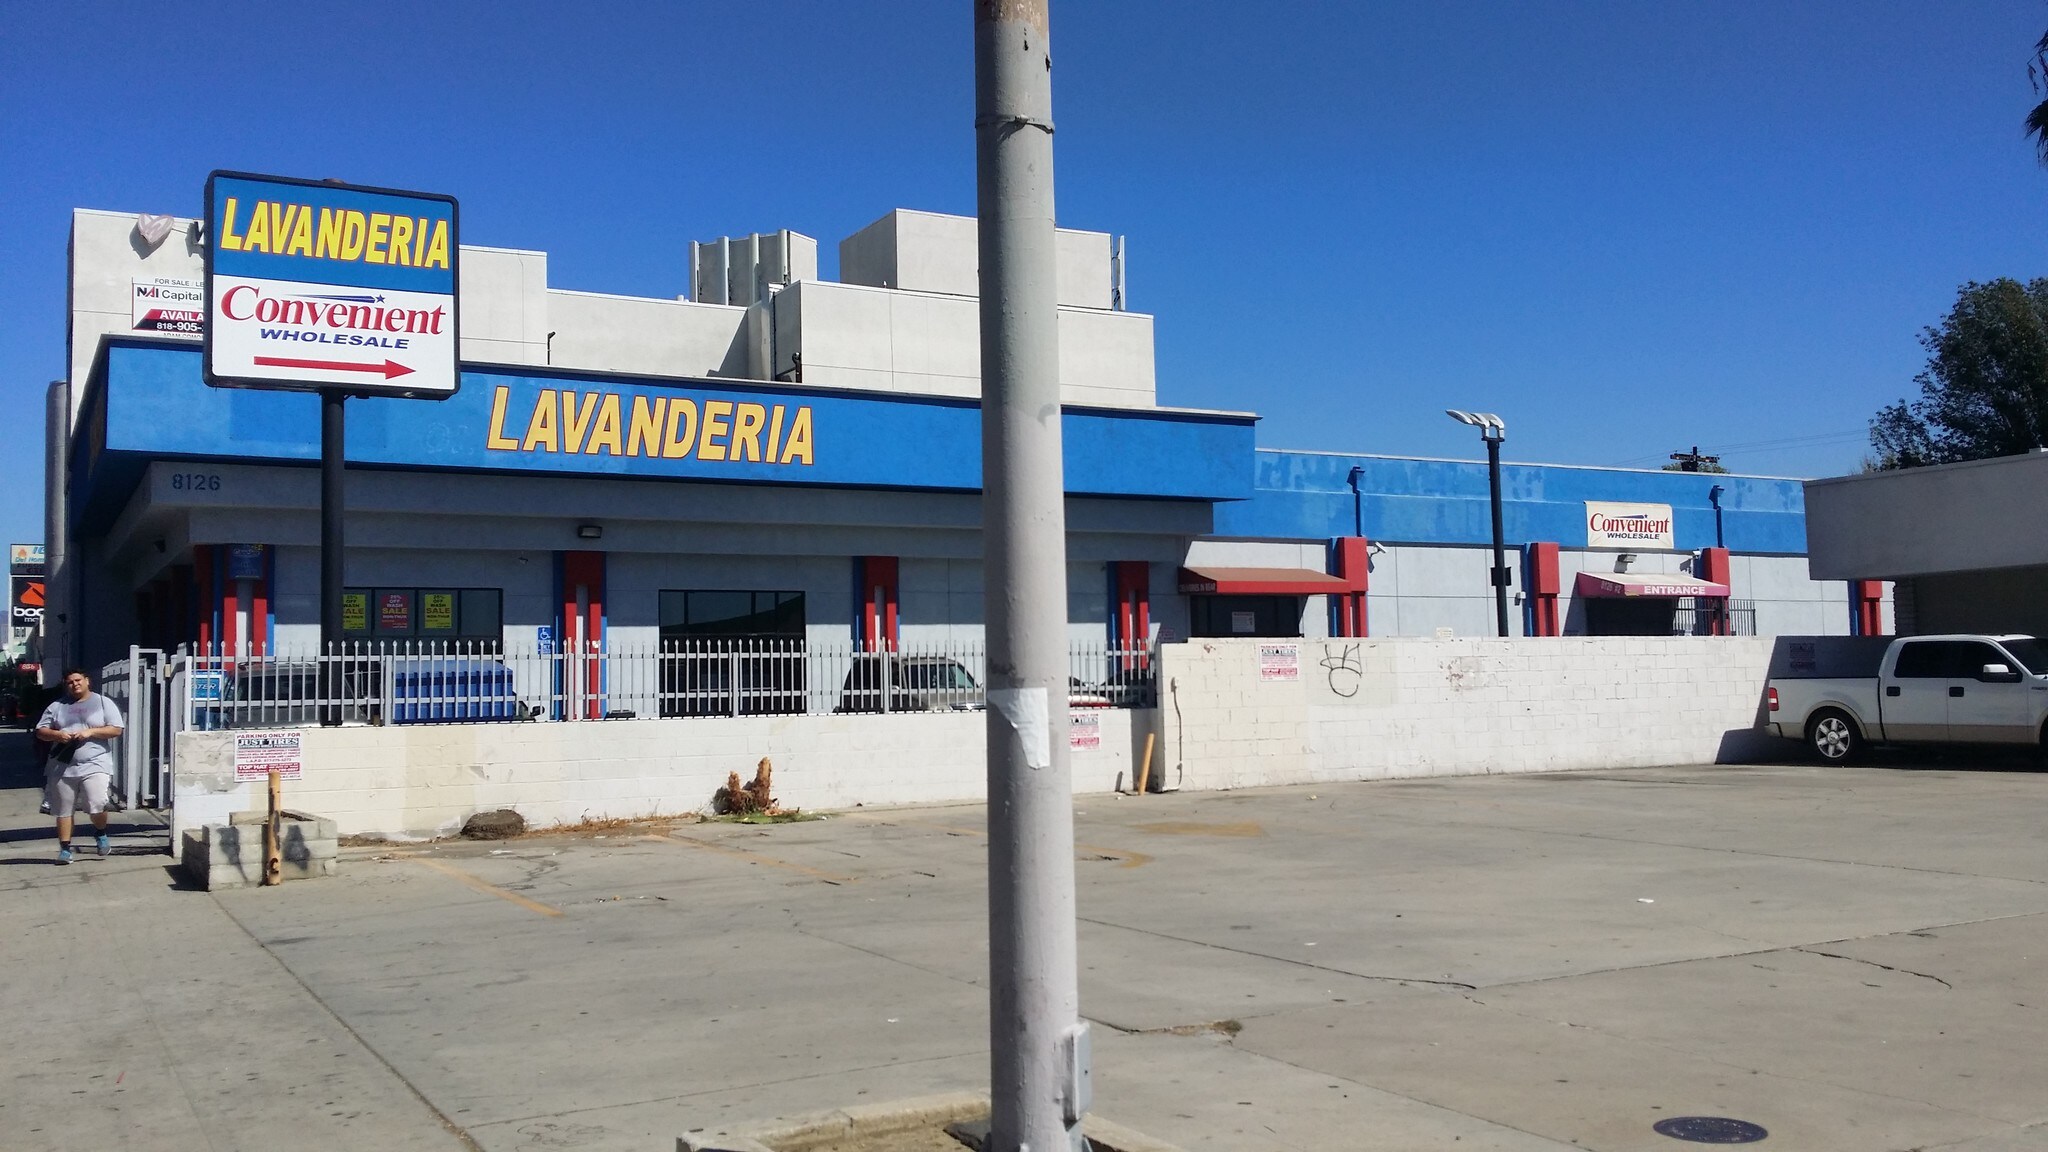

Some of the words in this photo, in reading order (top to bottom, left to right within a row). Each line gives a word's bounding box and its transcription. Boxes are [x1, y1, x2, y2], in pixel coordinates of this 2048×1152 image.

[220, 197, 450, 269] LAVANDERIA
[137, 286, 159, 299] NAI
[162, 289, 202, 302] Capital
[221, 285, 446, 336] Convenient
[156, 321, 204, 333] 818-905-
[260, 328, 410, 350] WHOLESALE
[487, 386, 814, 466] LAVANDERIA
[172, 473, 222, 491] 8126
[1590, 512, 1670, 534] Convenient
[1607, 532, 1660, 540] WHOLESALE
[1644, 585, 1706, 595] ENTRANCE
[345, 607, 365, 615] ALE
[382, 607, 408, 615] SALE
[238, 738, 265, 746] JUST
[268, 738, 298, 746] TIRES
